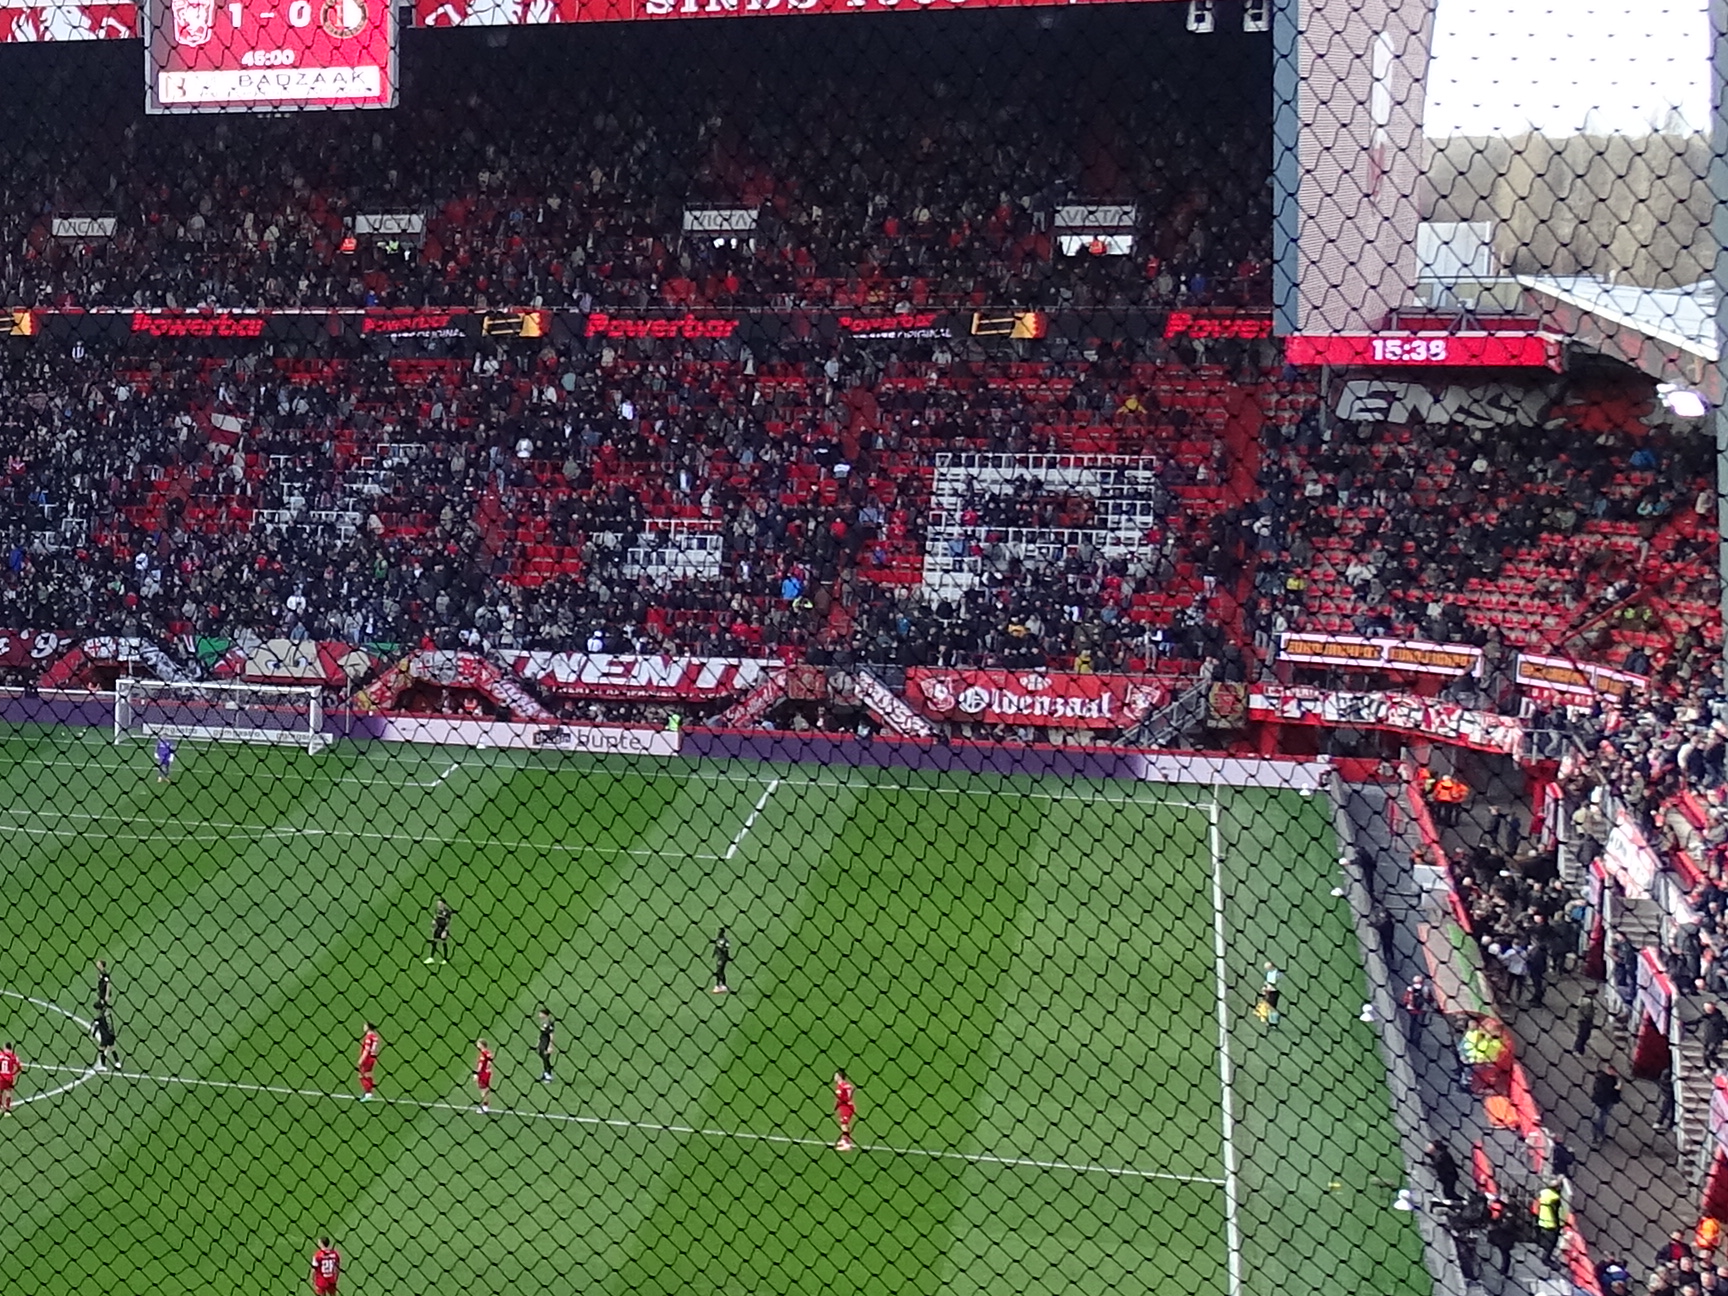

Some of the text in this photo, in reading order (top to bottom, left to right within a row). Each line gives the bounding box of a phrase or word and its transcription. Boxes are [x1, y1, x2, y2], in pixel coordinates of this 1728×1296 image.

[228, 2, 242, 28] 1
[289, 0, 312, 28] 0
[131, 312, 266, 337] Powerbar
[585, 311, 740, 339] Powerbar
[958, 687, 1112, 719] Oldenzaal
